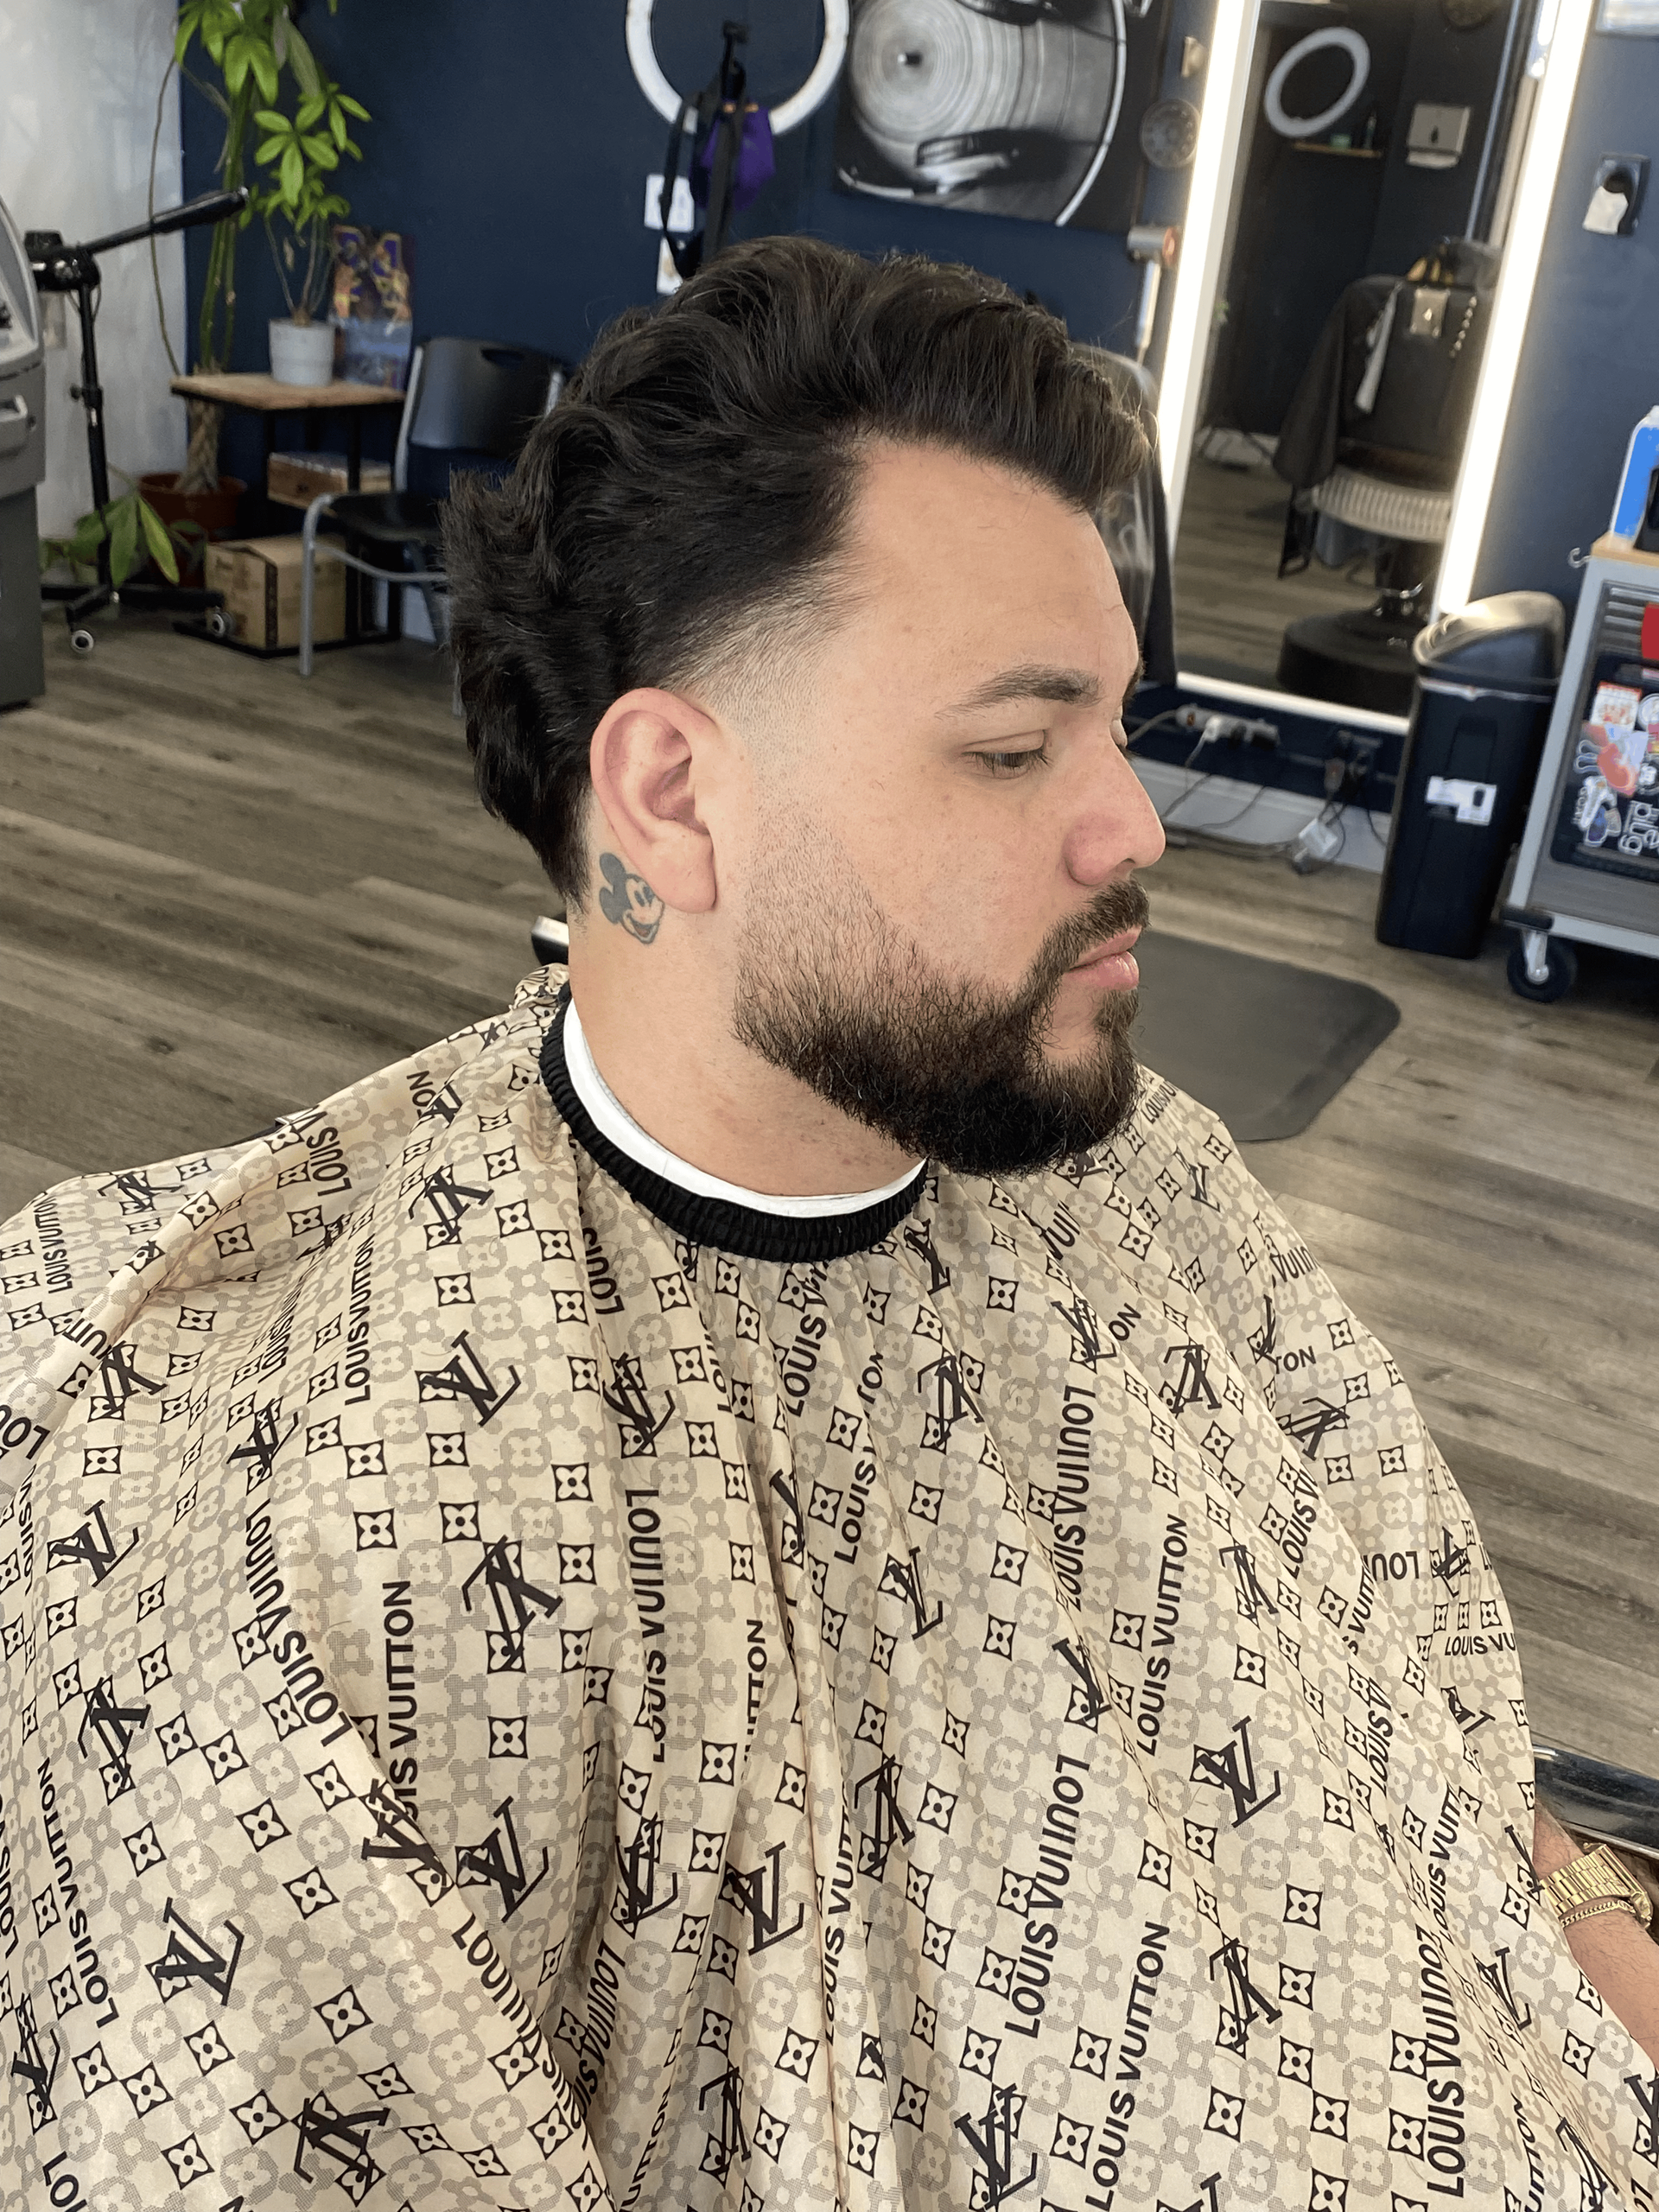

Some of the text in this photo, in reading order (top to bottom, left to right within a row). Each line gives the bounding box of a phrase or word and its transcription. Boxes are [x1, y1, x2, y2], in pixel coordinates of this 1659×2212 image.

[306, 1127, 353, 1197] LOUIS
[42, 1249, 73, 1294] LOUIS
[344, 1233, 376, 1406] LOUIS VUITTON
[784, 1313, 827, 1417] LOUIS
[834, 1459, 876, 1565] LOUIS
[1282, 1498, 1317, 1580] LOUIS
[273, 1630, 353, 1747] LOUIS
[382, 1580, 418, 1749] VUITTON
[1136, 1513, 1188, 1756] LOUIS VUITTON
[1445, 1636, 1488, 1656] LOUIS
[37, 1757, 119, 2028] LOUIS VUITTON
[1427, 1862, 1455, 1947] LOUIS
[1004, 1919, 1058, 2039] LOUIS
[1085, 1921, 1170, 2212] LOUIS VUITTON
[620, 2085, 671, 2208] UITTON
[1427, 2078, 1465, 2198] LOUIS
[1510, 2091, 1545, 2212] UITTON
